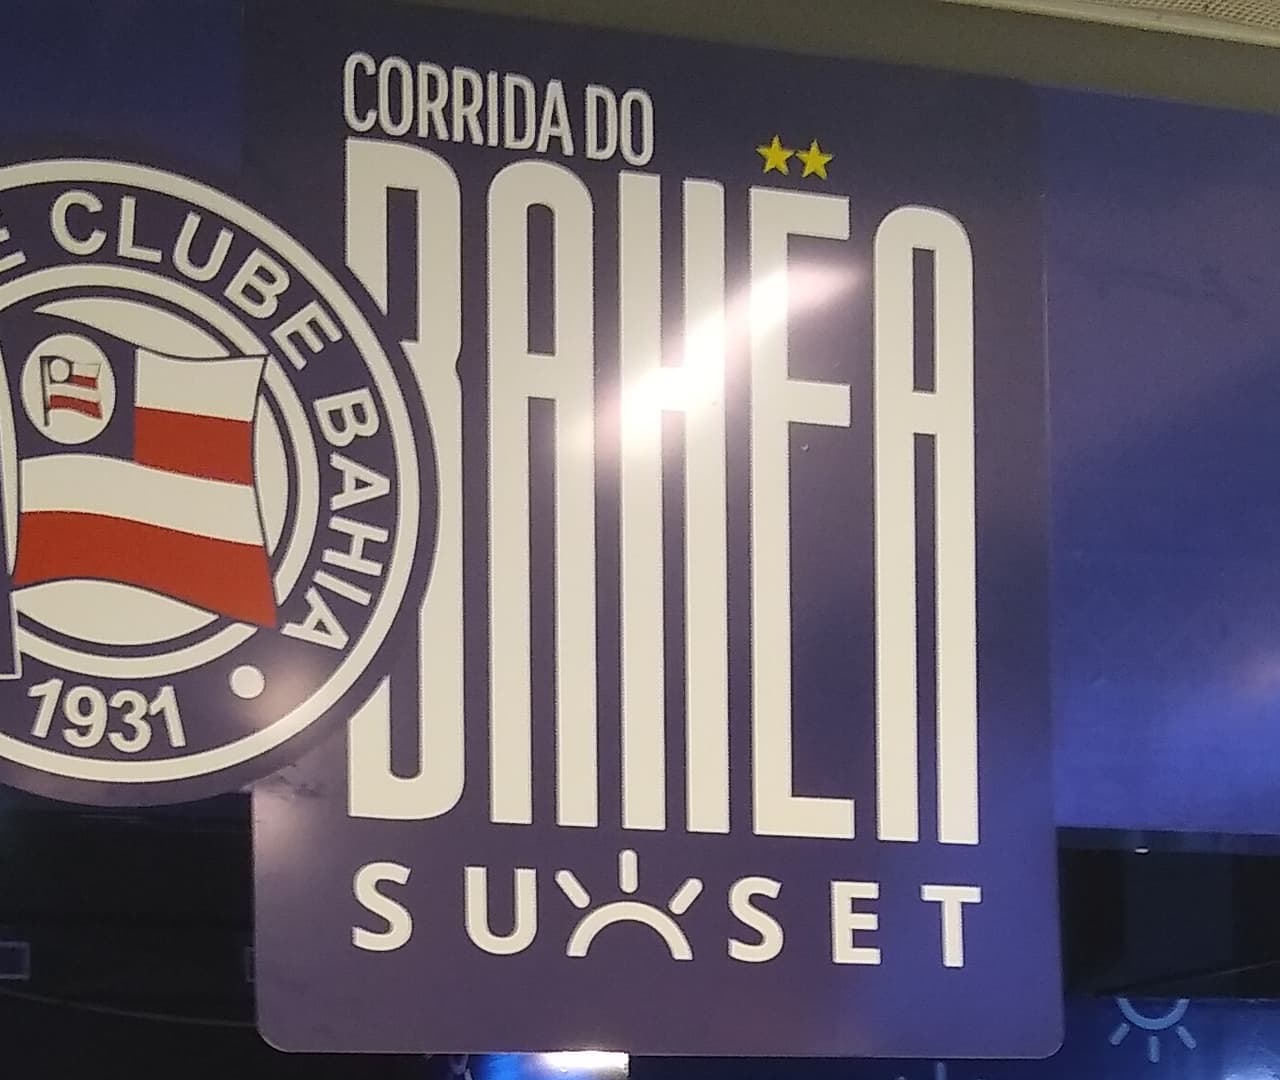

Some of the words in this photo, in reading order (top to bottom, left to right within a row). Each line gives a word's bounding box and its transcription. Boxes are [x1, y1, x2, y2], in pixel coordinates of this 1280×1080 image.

[344, 51, 574, 156] CORRIDA
[586, 83, 654, 167] DO
[50, 190, 343, 371] CLUBE
[279, 387, 391, 651] BAHIA
[27, 677, 186, 754] 1931
